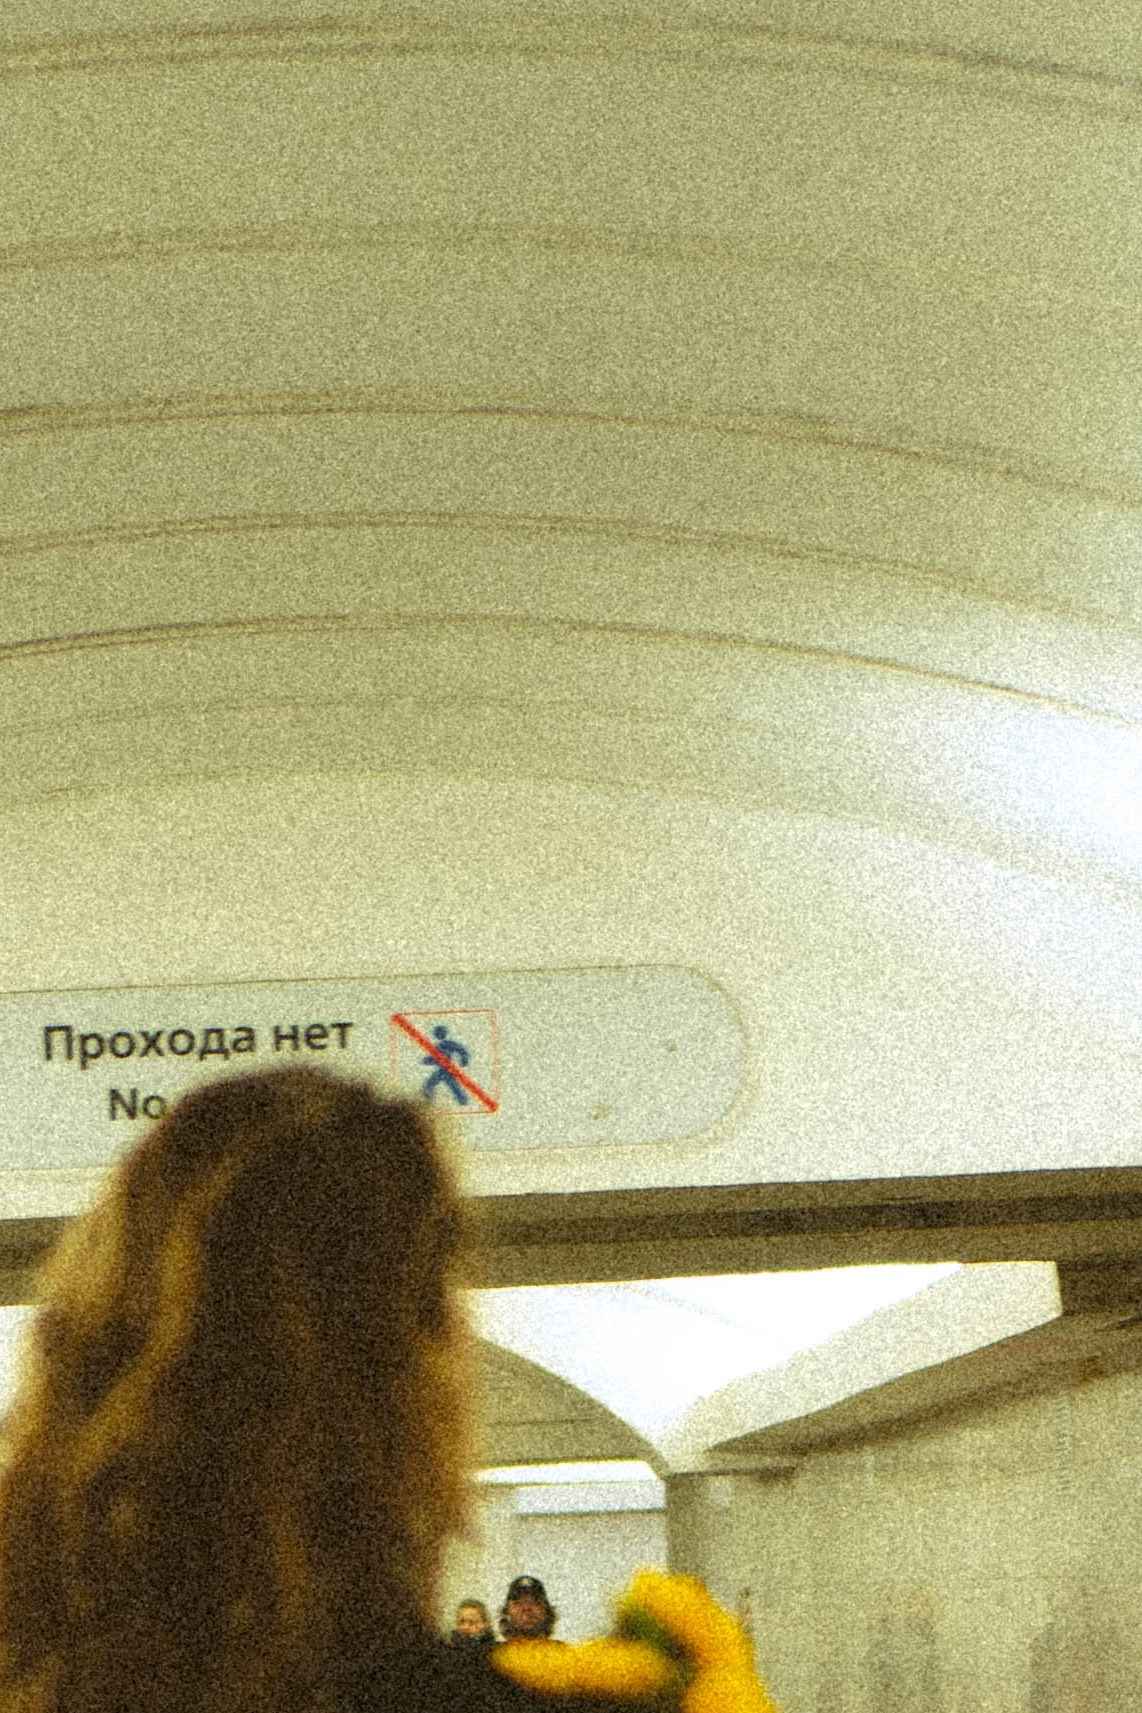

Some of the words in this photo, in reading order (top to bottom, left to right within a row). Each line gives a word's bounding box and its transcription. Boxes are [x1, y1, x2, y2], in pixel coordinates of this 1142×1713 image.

[43, 1024, 255, 1070] Прохода
[274, 1021, 354, 1052] нет
[109, 1088, 168, 1121] No
